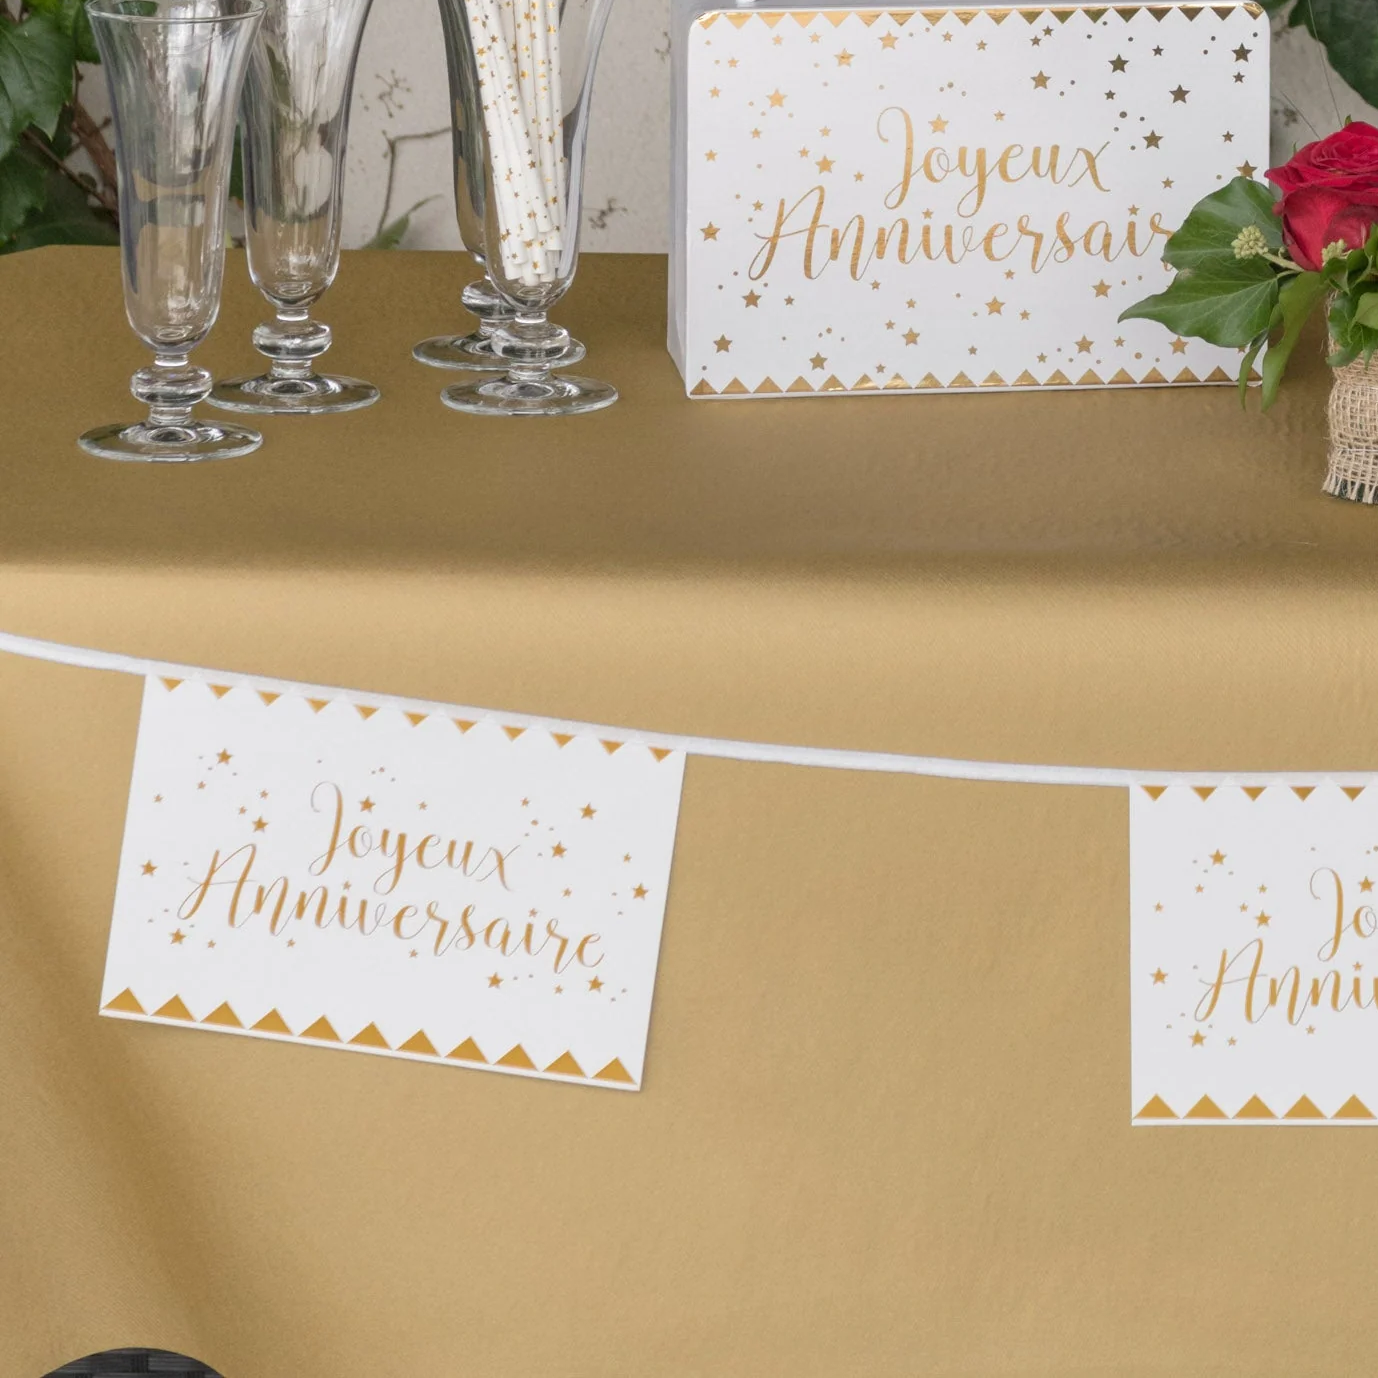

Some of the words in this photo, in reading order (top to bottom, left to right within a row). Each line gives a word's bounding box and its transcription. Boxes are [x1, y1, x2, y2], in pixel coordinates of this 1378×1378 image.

[876, 105, 1111, 218] Joyeux
[747, 184, 1176, 285] Anniversair
[308, 781, 521, 895] Joyeux
[177, 843, 605, 975] Anniversaire
